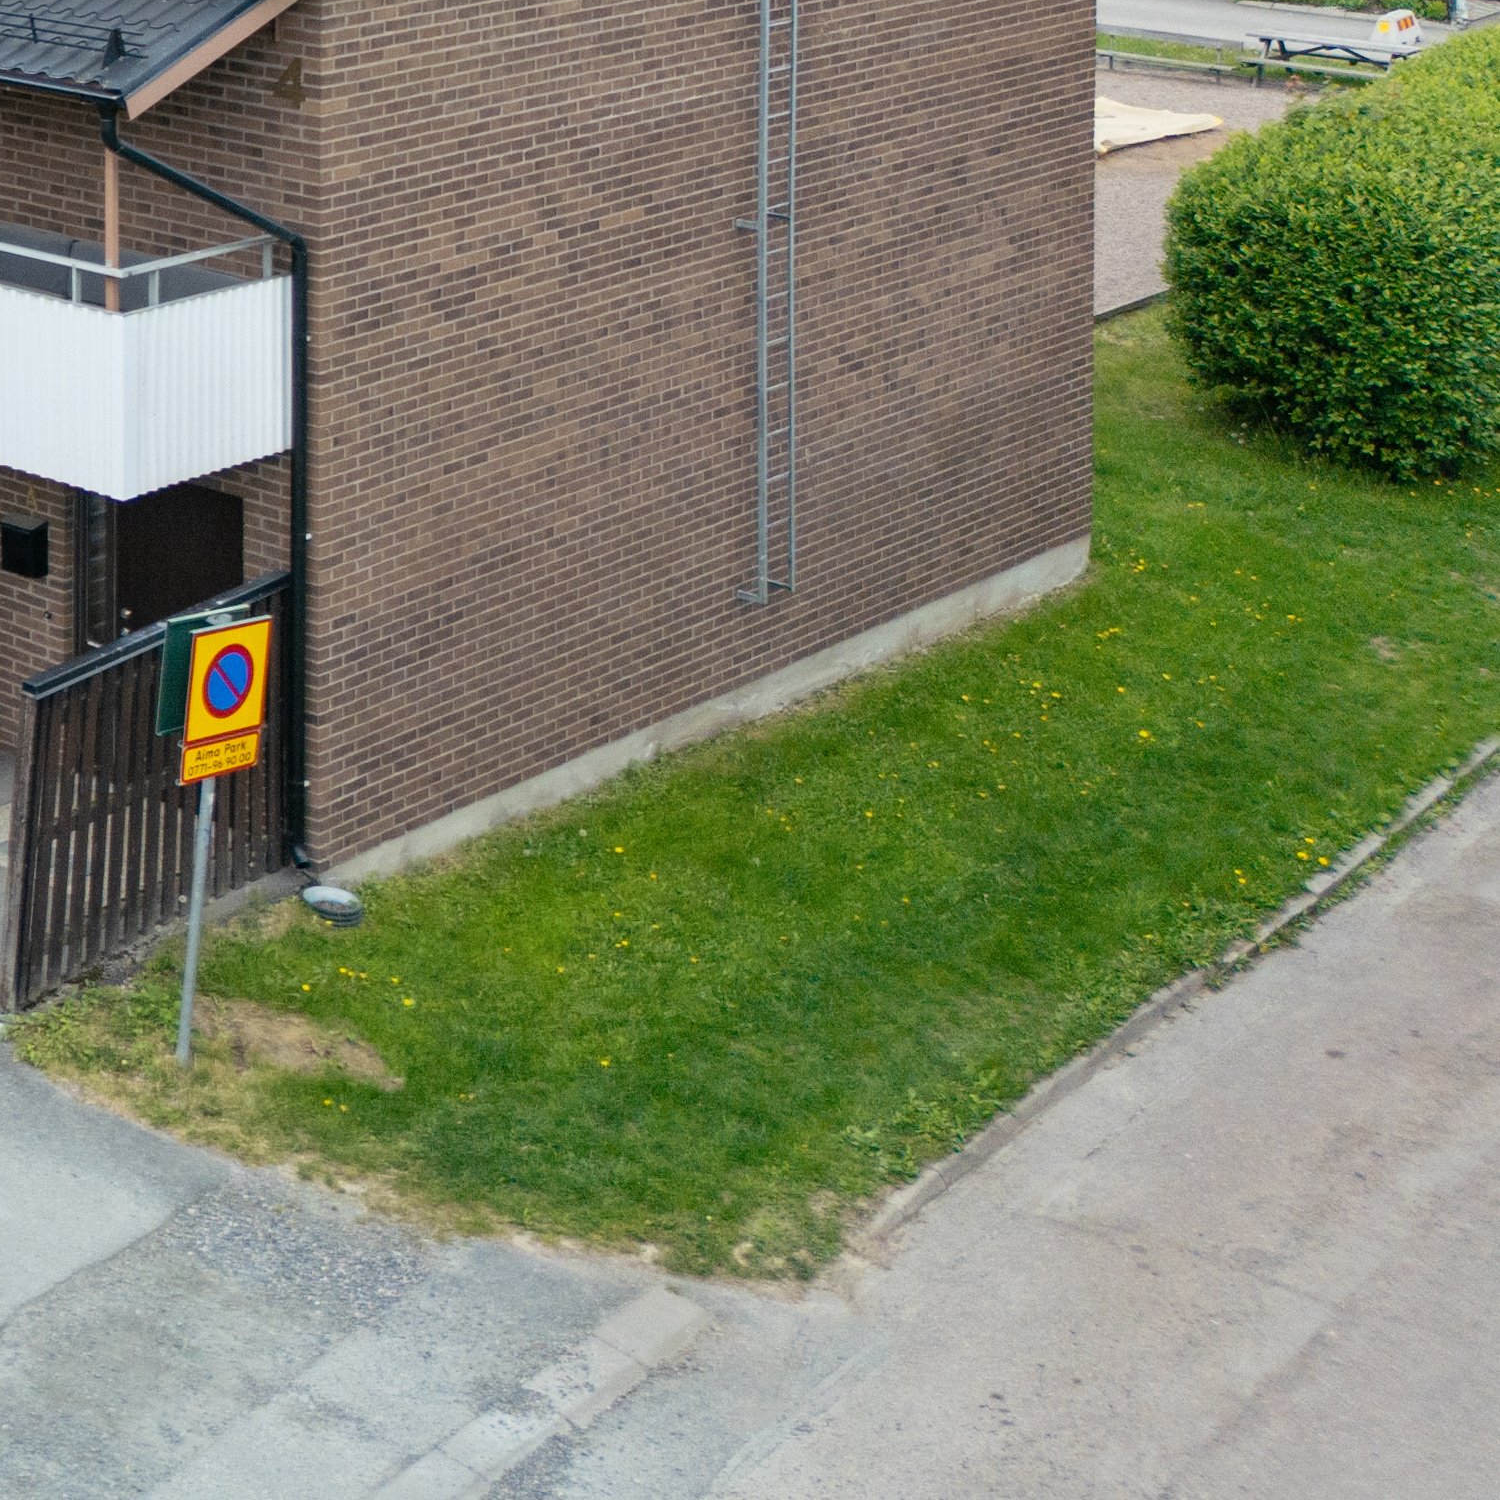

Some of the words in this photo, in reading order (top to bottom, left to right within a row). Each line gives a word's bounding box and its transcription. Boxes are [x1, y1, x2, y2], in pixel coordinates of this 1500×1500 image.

[272, 57, 306, 109] 4
[188, 759, 222, 776] 0771-96
[225, 756, 237, 765] 90
[239, 752, 251, 762] 00
[195, 749, 220, 763] Aimo
[224, 741, 246, 753] Park
